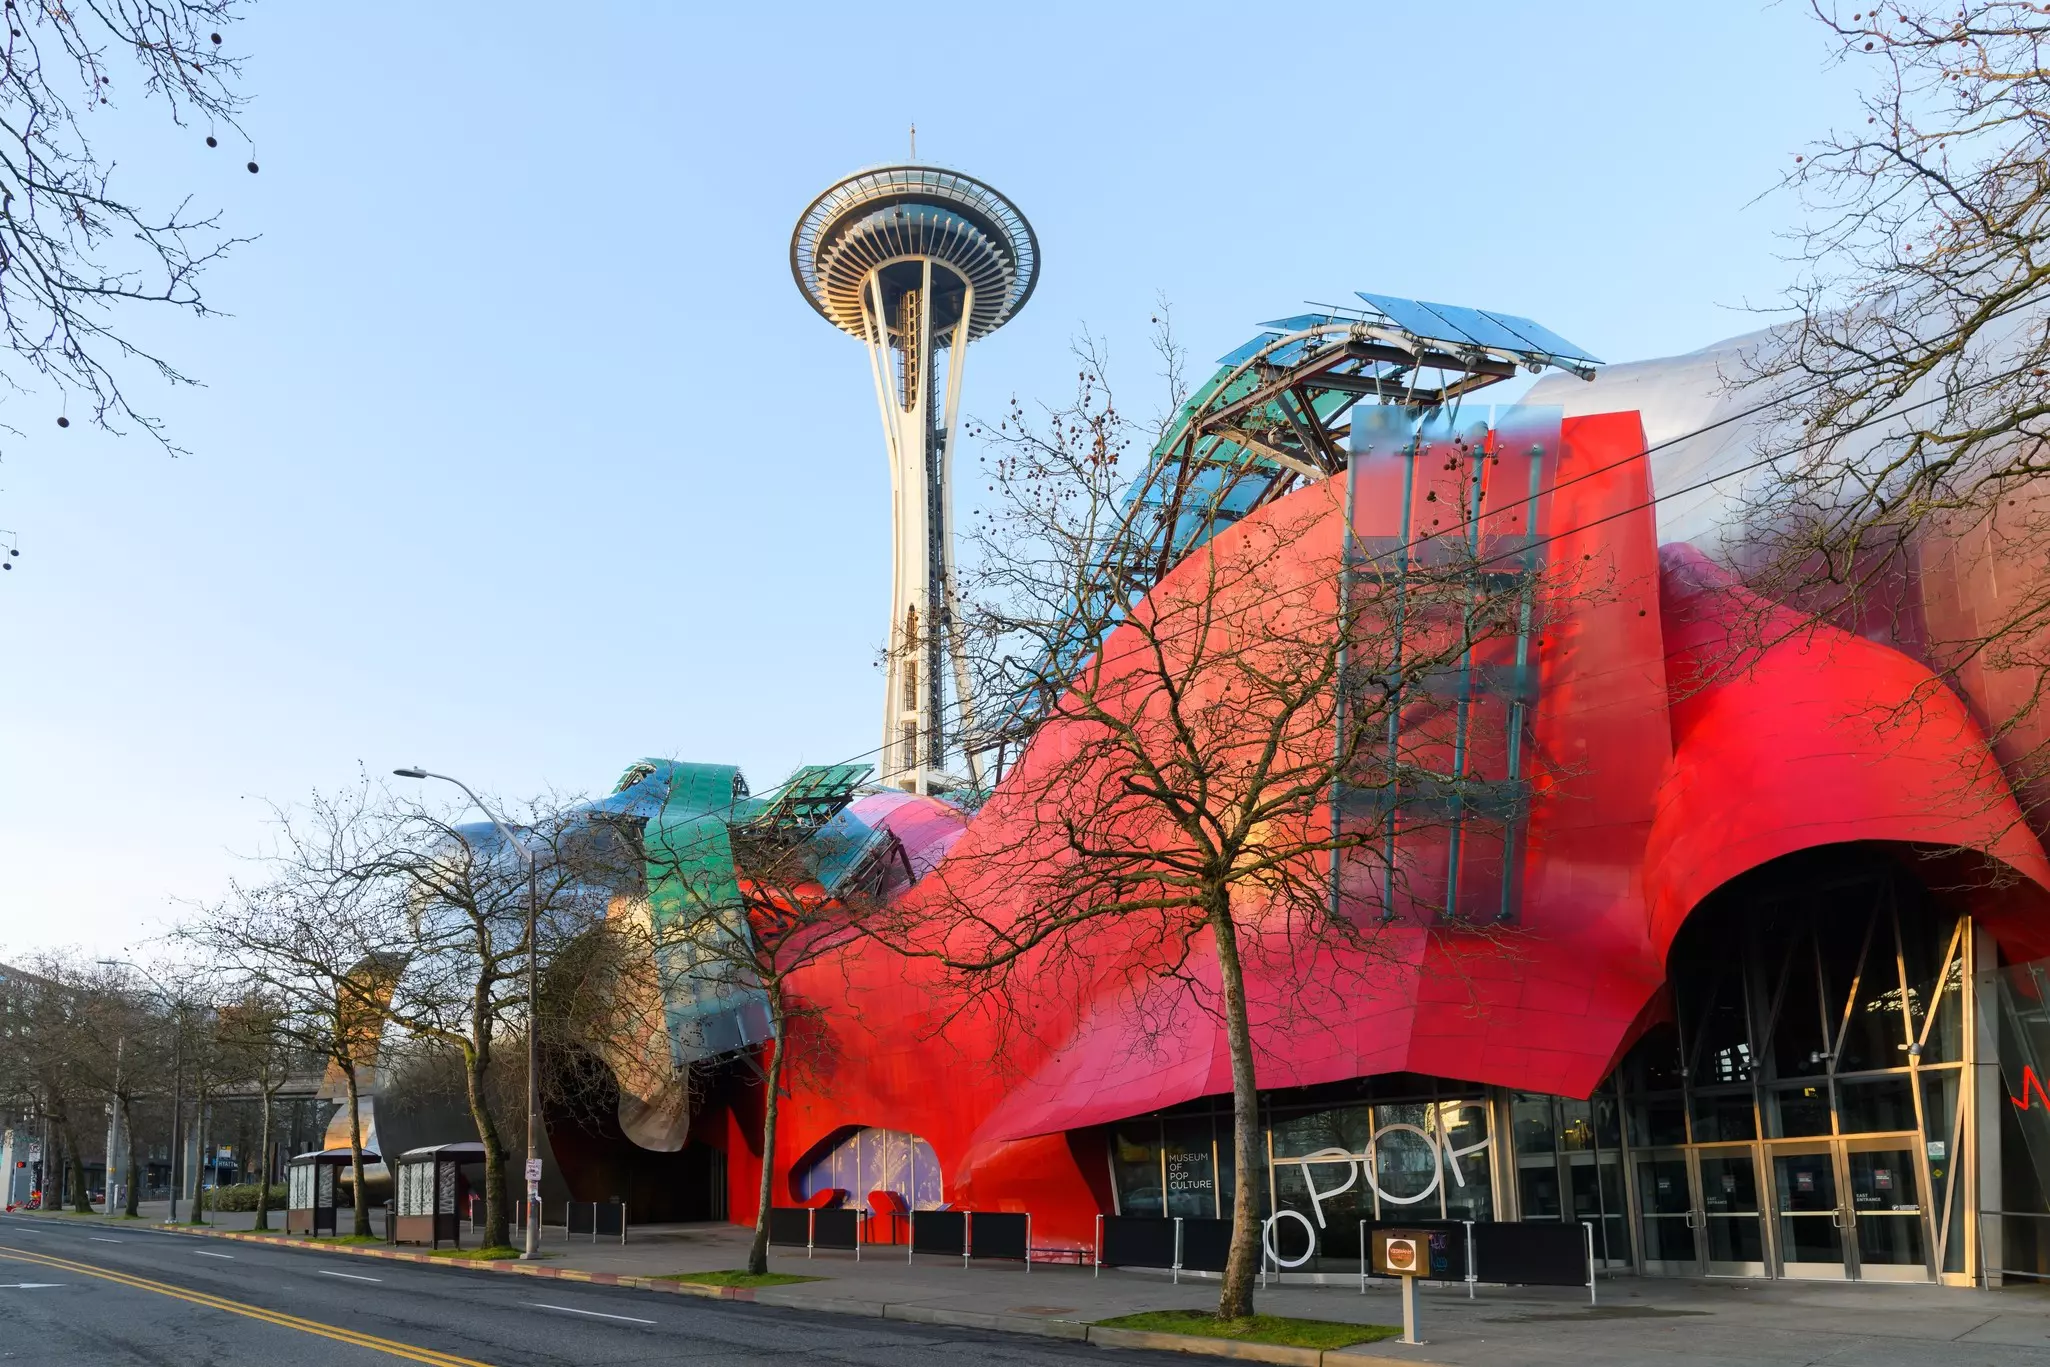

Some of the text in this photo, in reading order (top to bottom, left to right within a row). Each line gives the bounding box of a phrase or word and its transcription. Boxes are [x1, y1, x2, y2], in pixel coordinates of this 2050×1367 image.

[1169, 1153, 1208, 1162] MUSEUM
[1169, 1163, 1183, 1171] OF
[1170, 1172, 1189, 1180] POP
[1170, 1180, 1212, 1189] CULTURE
